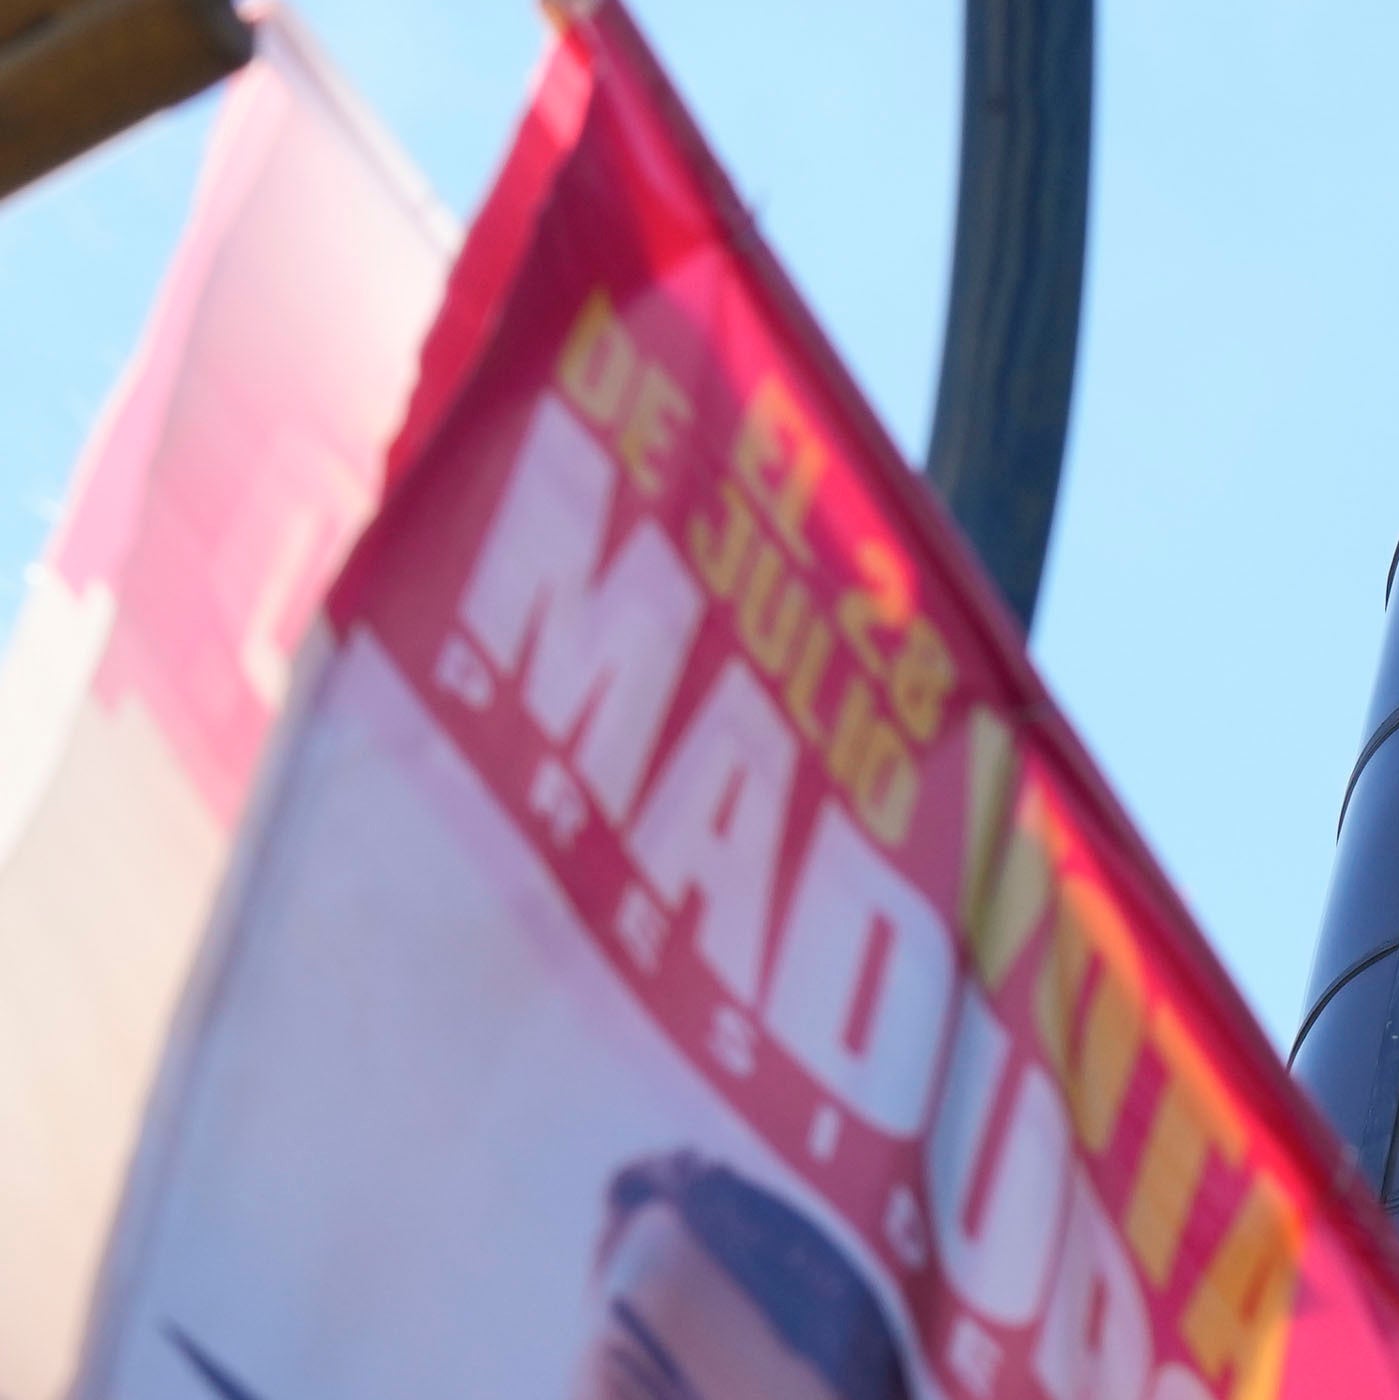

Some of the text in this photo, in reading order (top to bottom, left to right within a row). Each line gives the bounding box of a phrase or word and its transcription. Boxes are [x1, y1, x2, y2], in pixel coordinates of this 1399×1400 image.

[556, 287, 920, 847] DE JULIO
[731, 374, 956, 742] EL 28
